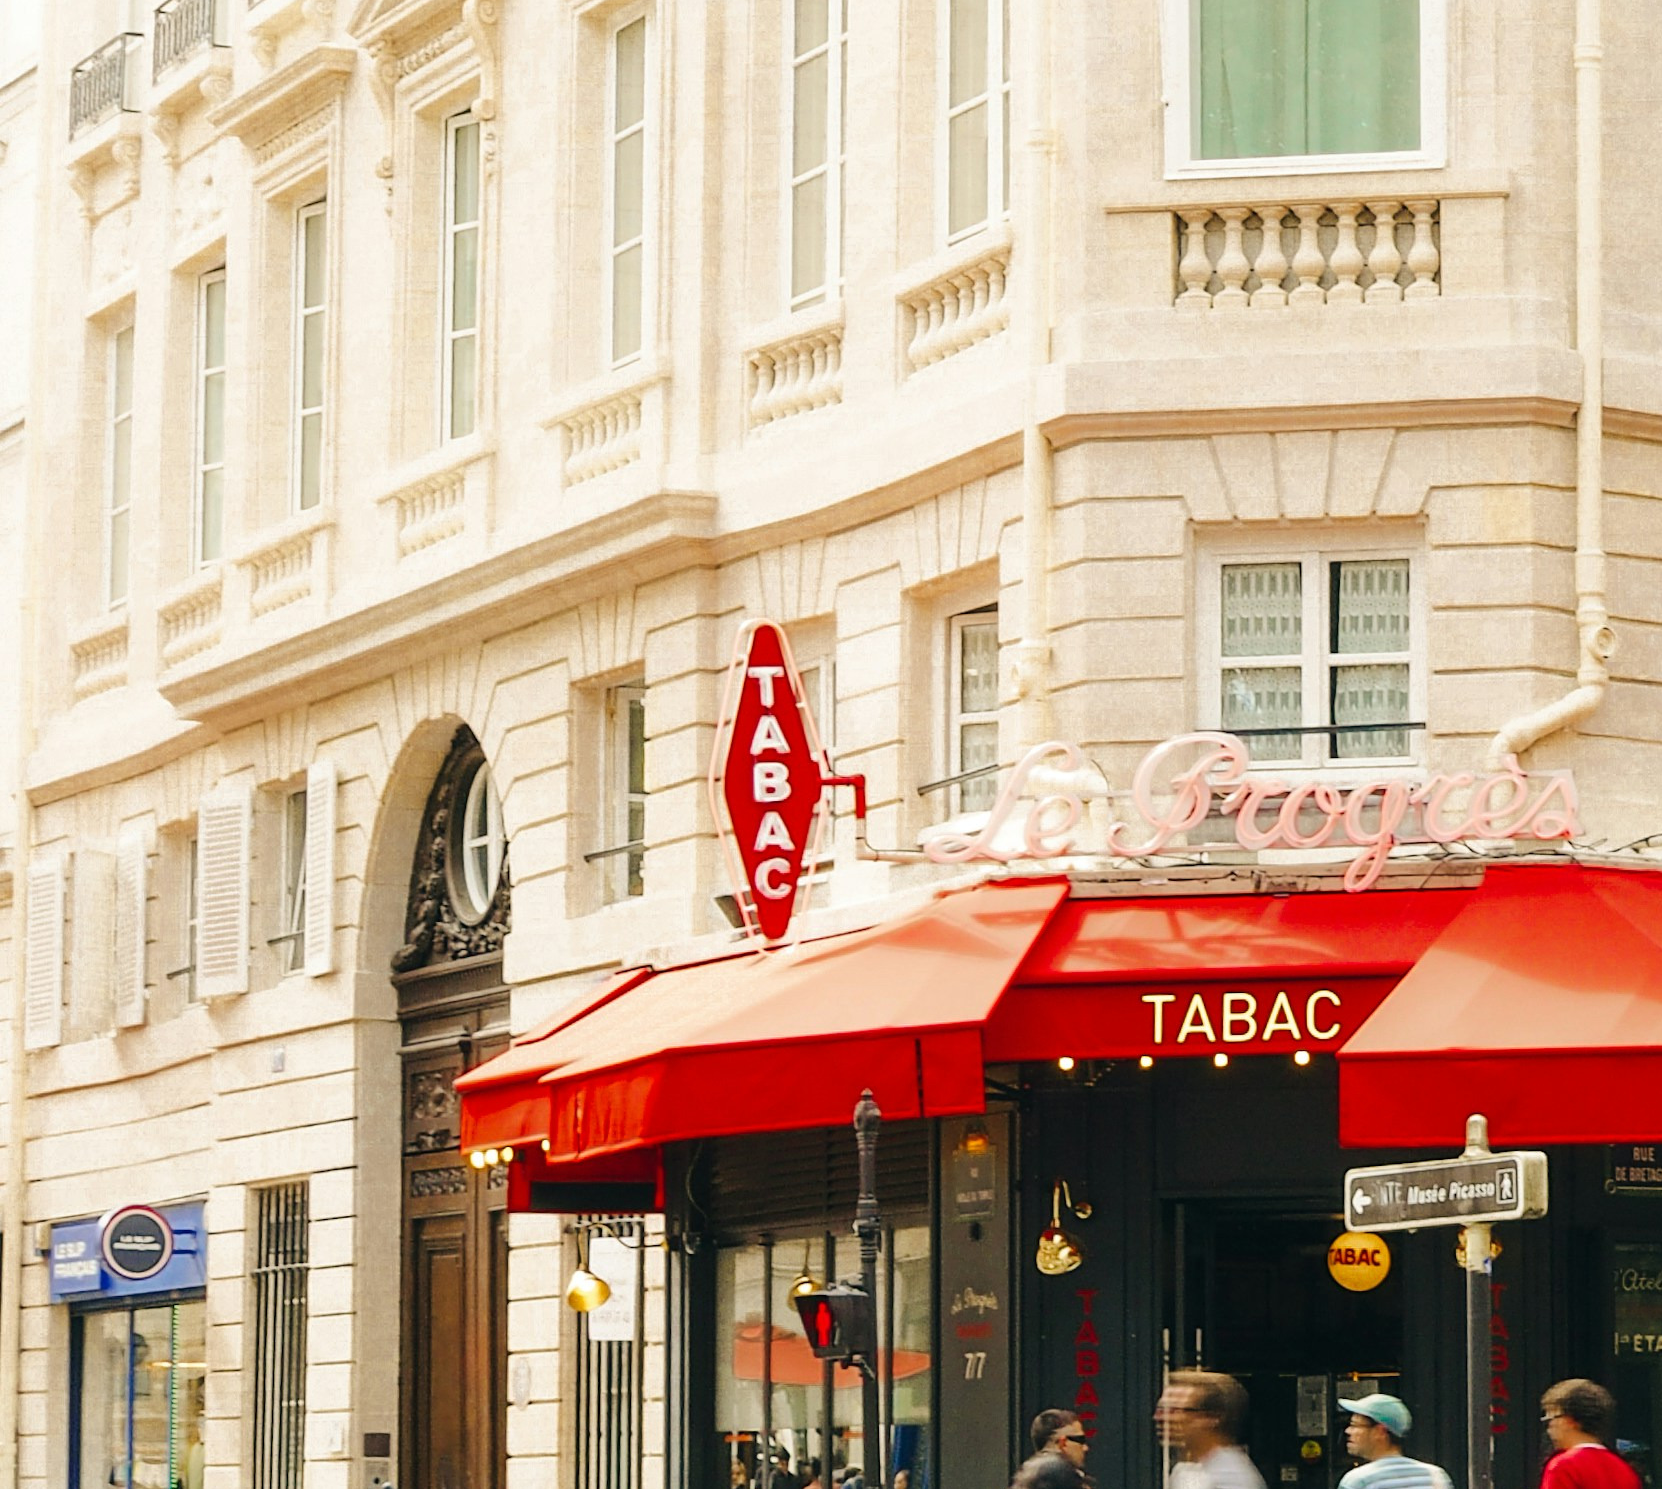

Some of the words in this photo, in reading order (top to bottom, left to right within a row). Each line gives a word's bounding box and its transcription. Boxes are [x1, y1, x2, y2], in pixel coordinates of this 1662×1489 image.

[747, 666, 795, 900] TABAC
[924, 741, 1086, 863] Le
[1108, 731, 1583, 893] Progrès
[1142, 990, 1342, 1045] TABAC
[1632, 1146, 1656, 1162] RUE
[1615, 1166, 1627, 1181] DE
[1407, 1184, 1446, 1205] Musée
[1449, 1181, 1495, 1200] Picasso
[1328, 1248, 1381, 1267] TABAC
